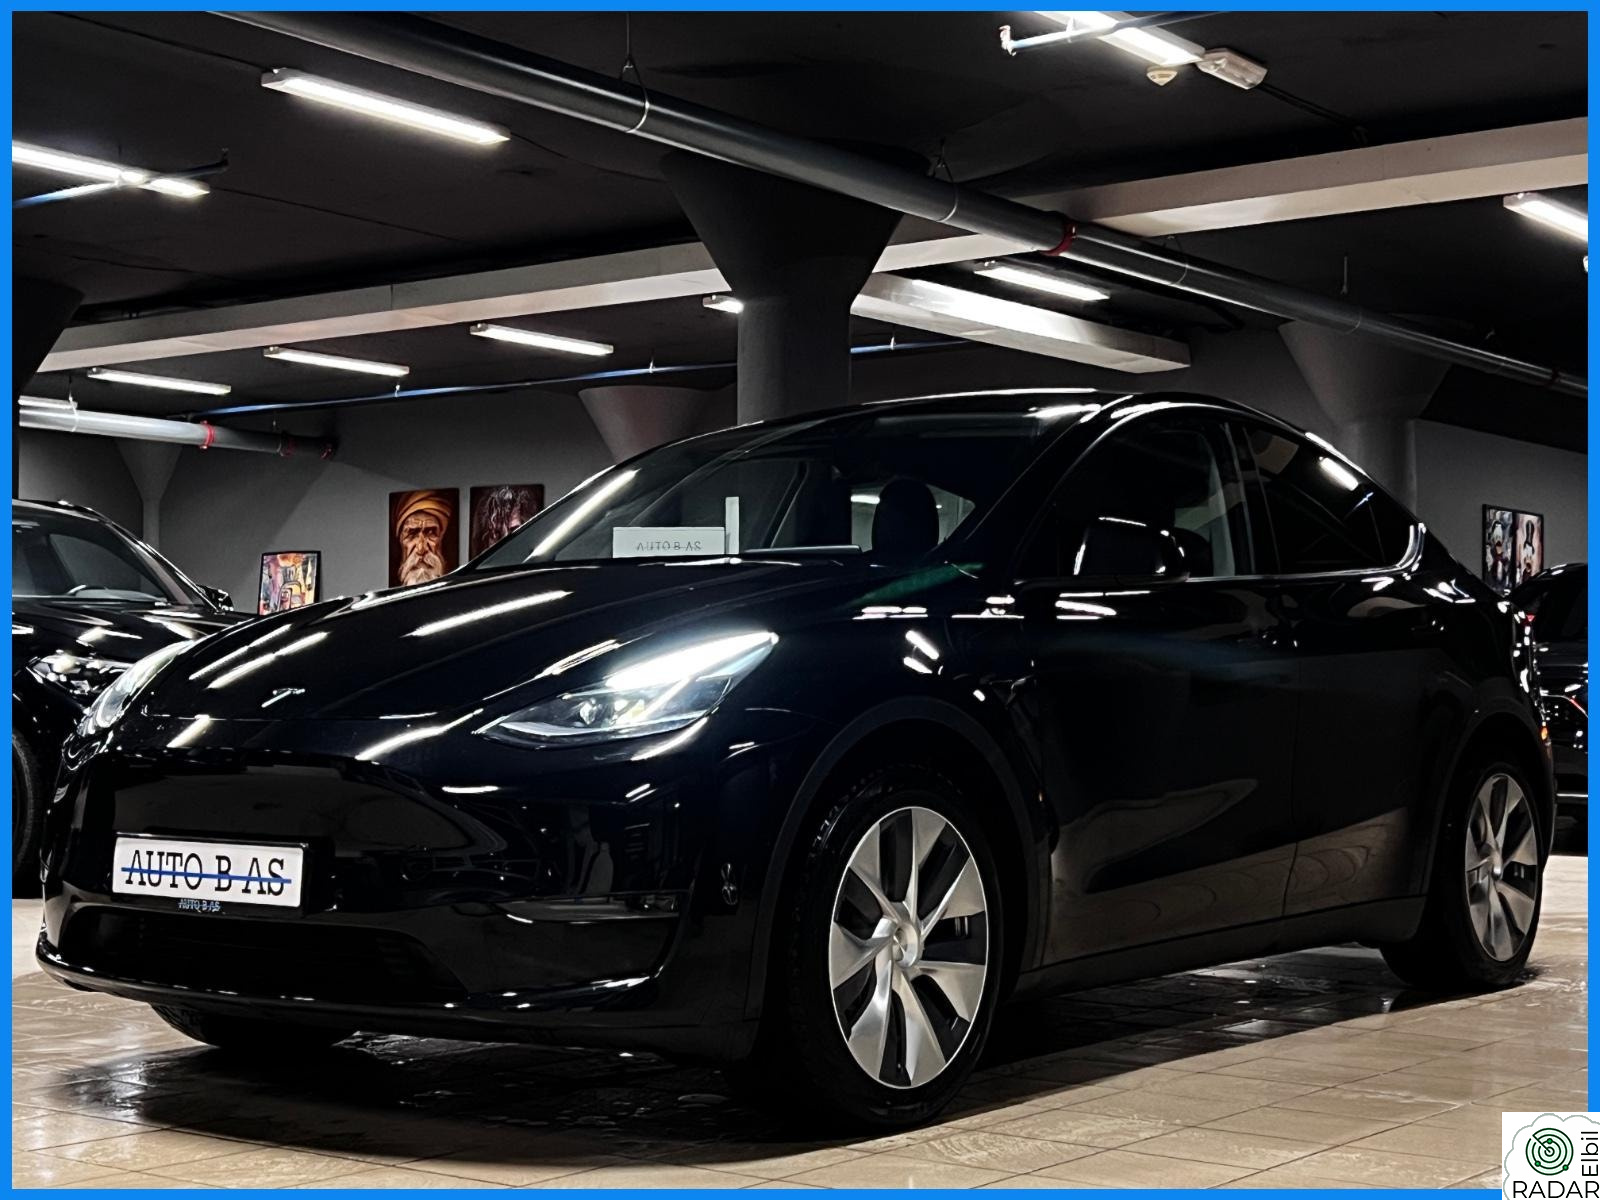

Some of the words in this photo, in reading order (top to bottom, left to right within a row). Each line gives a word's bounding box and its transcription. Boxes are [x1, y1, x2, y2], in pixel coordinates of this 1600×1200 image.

[125, 849, 203, 891] AUTO
[214, 854, 232, 892] B
[242, 857, 285, 896] AS
